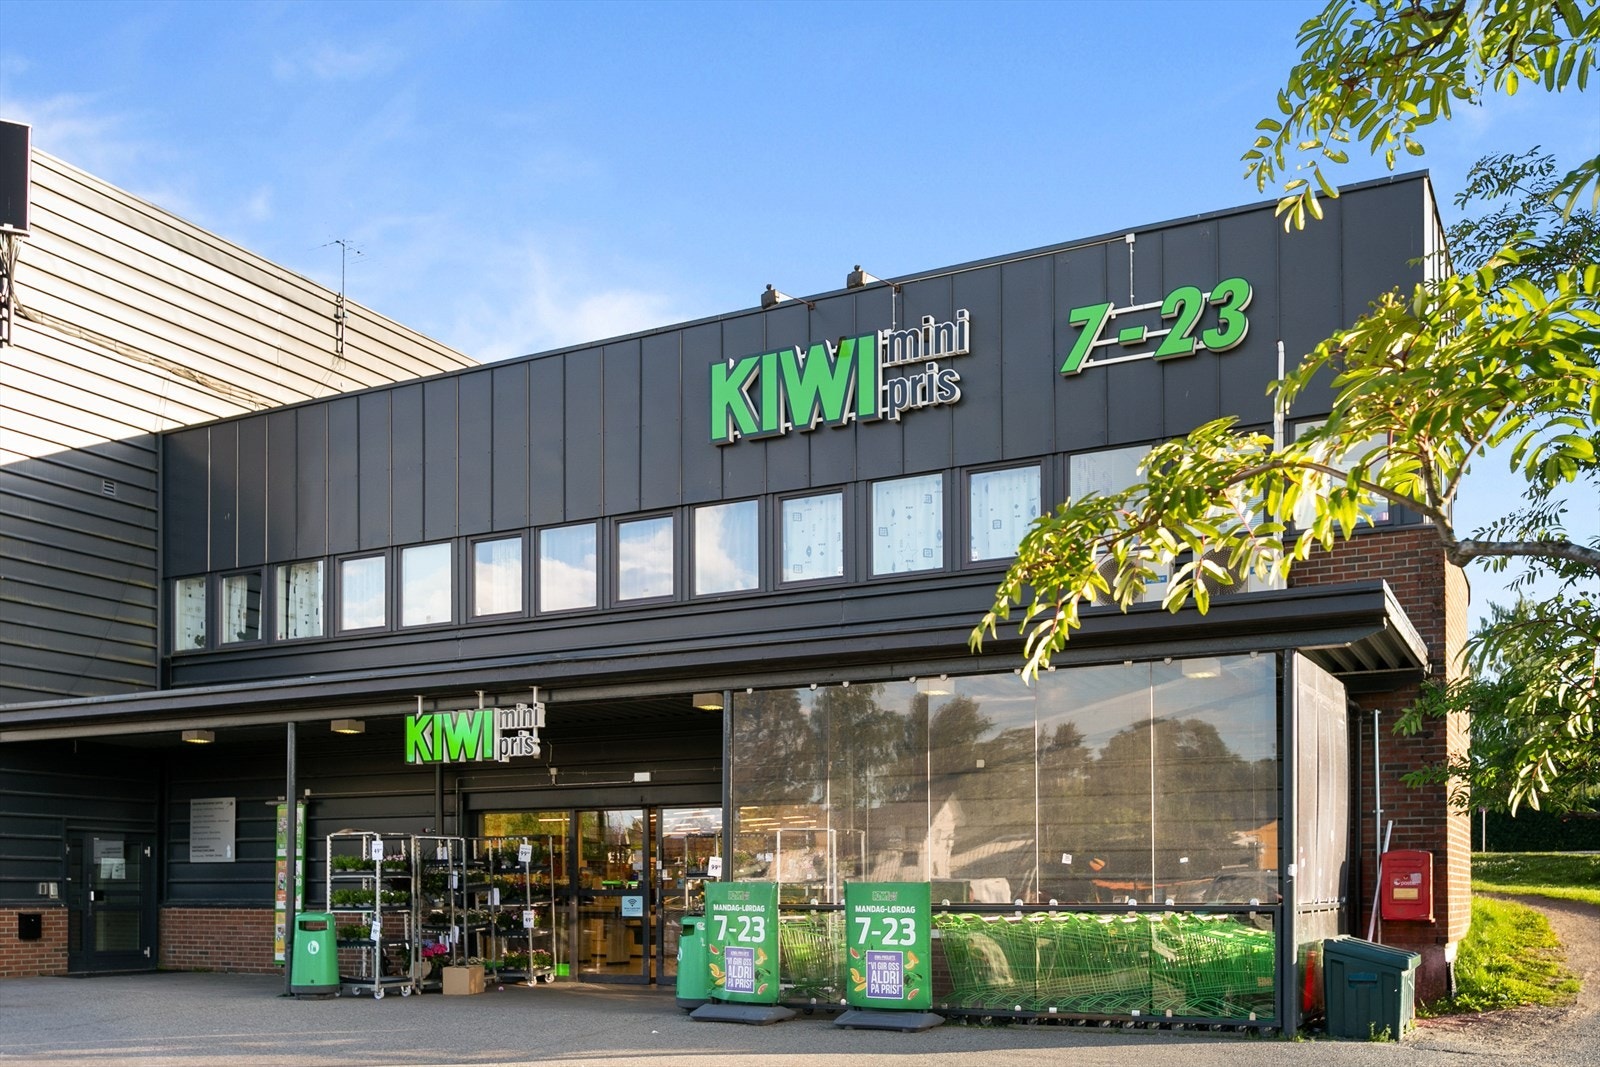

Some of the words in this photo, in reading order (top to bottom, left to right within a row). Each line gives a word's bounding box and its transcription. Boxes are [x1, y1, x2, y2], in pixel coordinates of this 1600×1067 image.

[888, 309, 969, 365] mini
[1060, 277, 1252, 375] 7-23
[709, 330, 881, 446] KIWI
[888, 362, 960, 420] pris
[499, 703, 543, 729] mini
[405, 708, 497, 764] KIWI
[499, 730, 538, 762] pris
[713, 903, 765, 913] MANDAG-LØRDAG
[855, 905, 916, 914] MANDAG-LØRDAG
[713, 915, 766, 943] 7-23
[855, 917, 917, 946] 7-23
[728, 965, 752, 979] ALDRI
[871, 970, 900, 985] ALDRI
